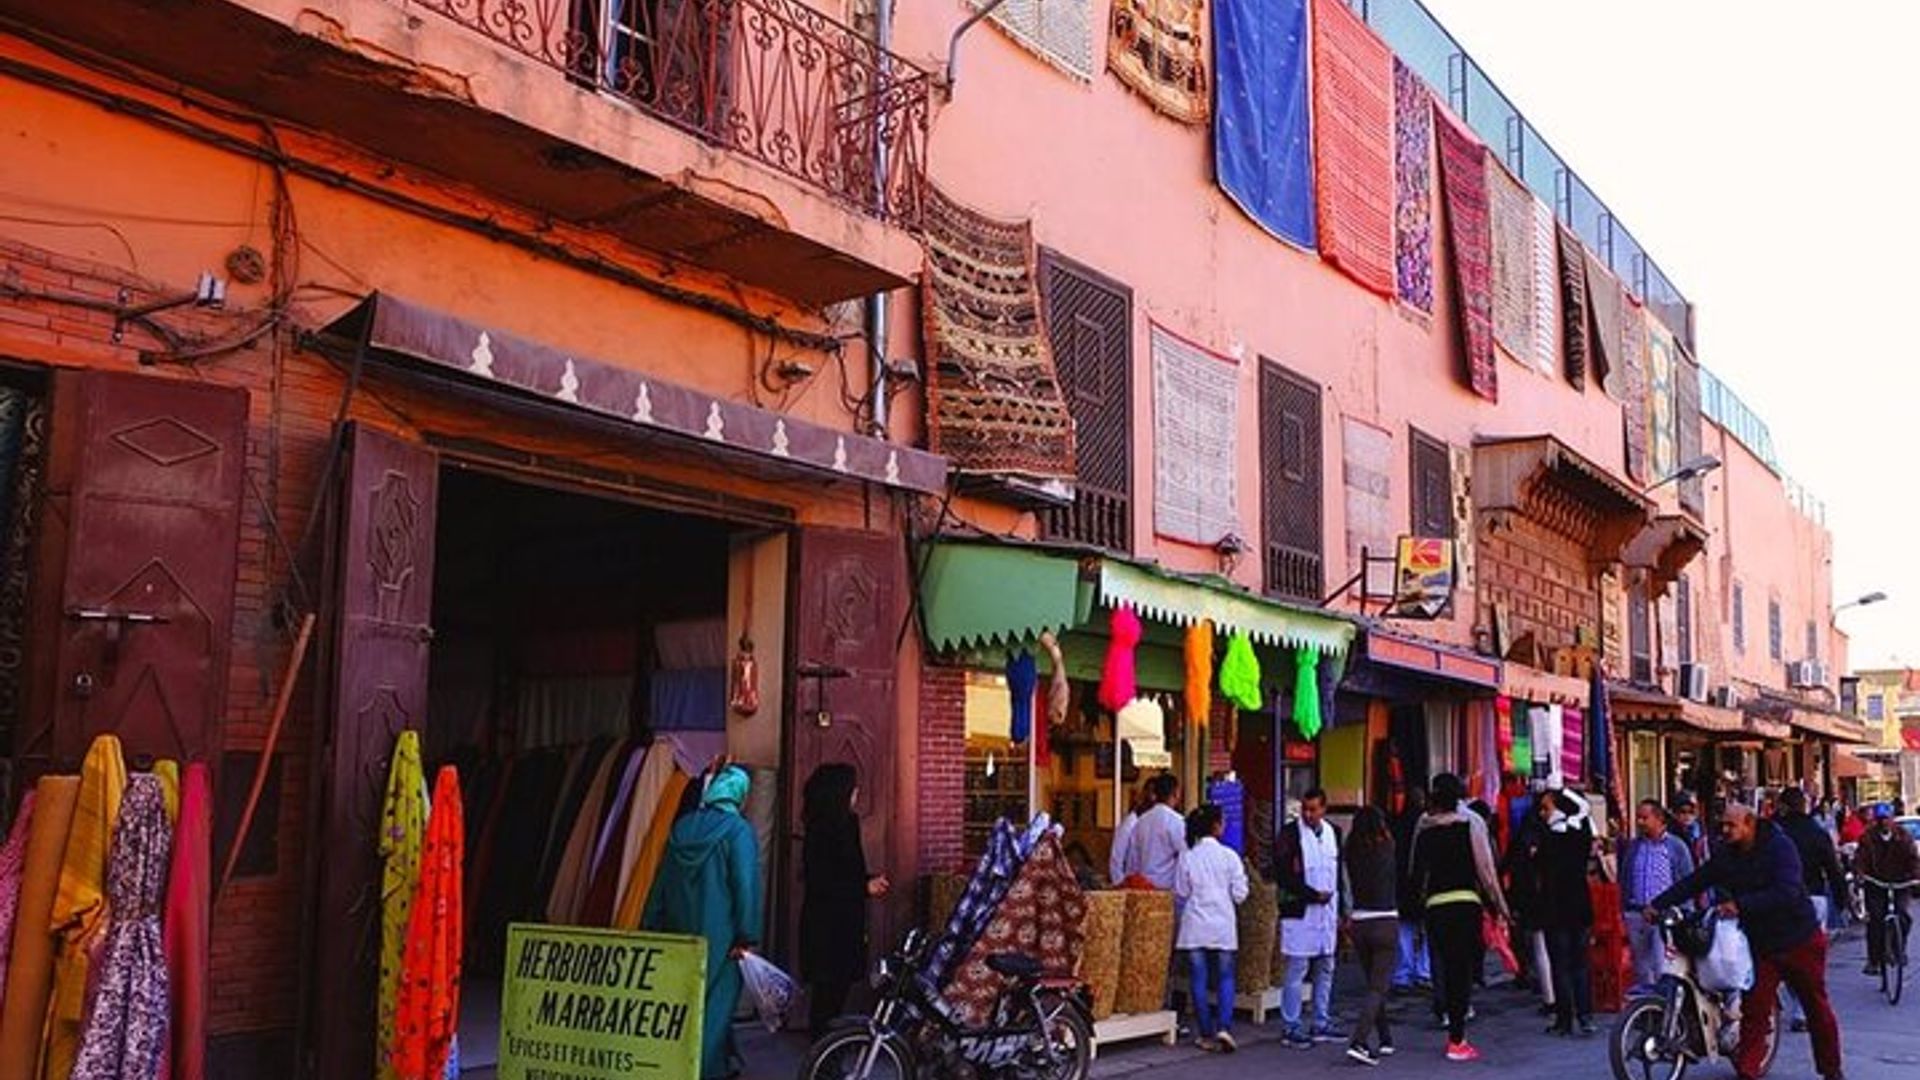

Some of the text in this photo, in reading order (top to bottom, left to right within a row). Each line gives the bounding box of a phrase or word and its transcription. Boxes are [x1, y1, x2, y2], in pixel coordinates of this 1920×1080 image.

[516, 938, 664, 991] HERBORISTE
[535, 991, 688, 1041] MARRAKECH
[570, 1044, 634, 1072] PLANTES
